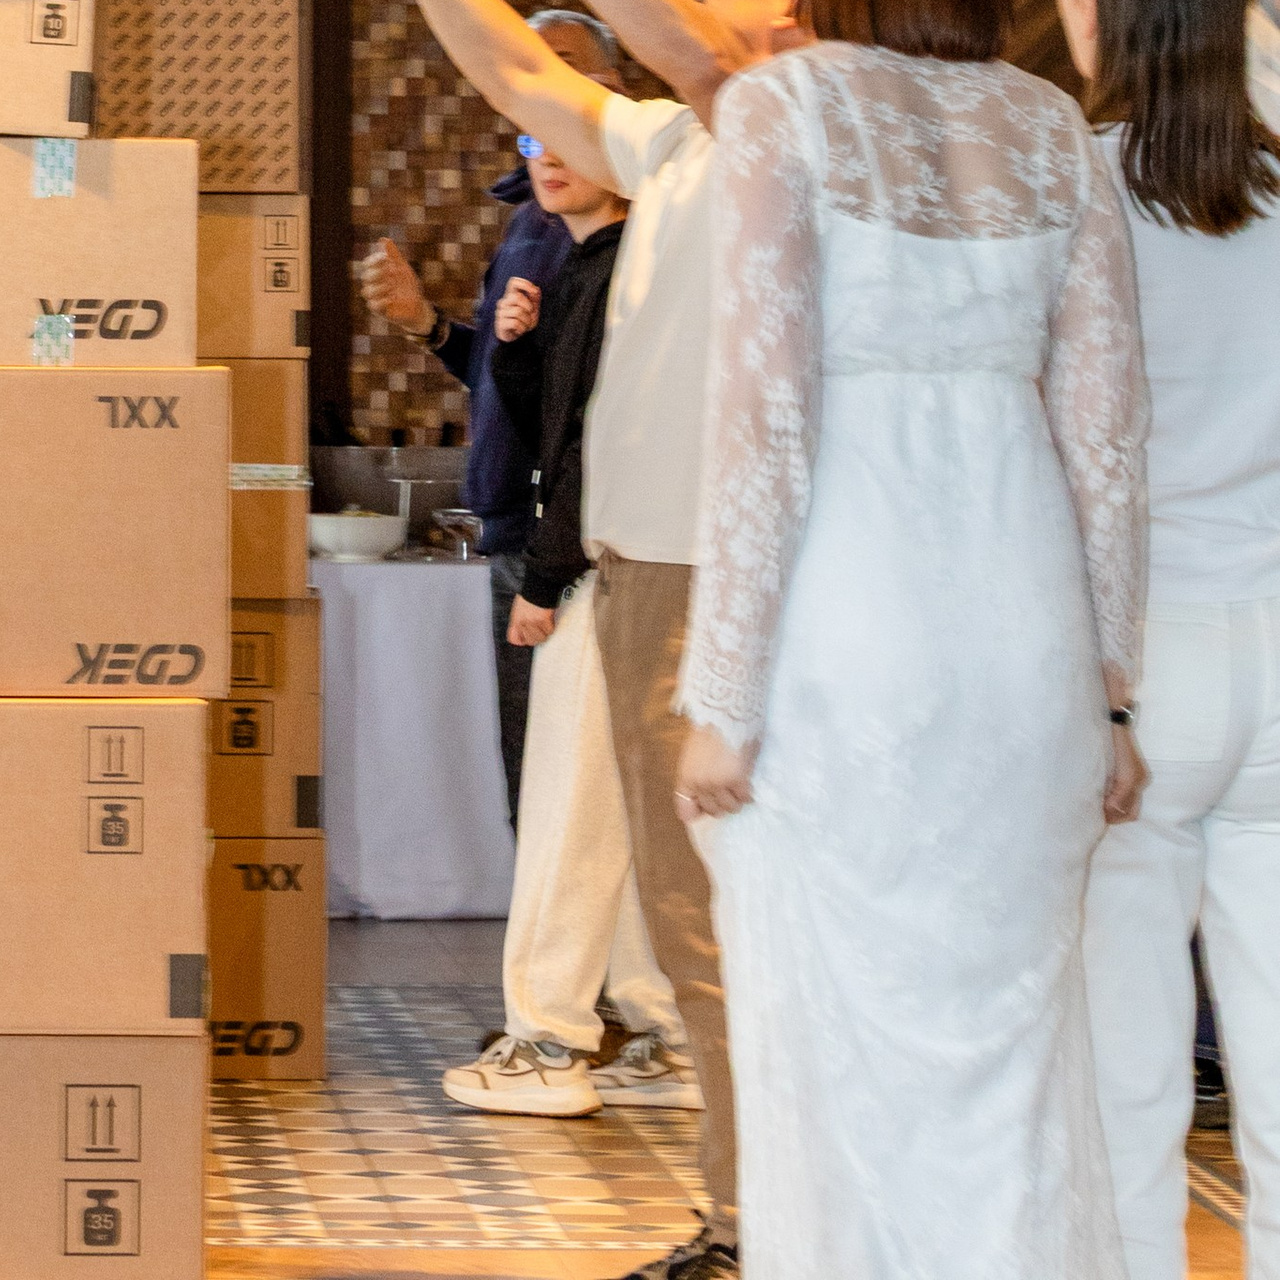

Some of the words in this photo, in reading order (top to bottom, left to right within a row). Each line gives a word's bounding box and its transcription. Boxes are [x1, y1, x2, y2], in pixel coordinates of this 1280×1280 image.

[97, 396, 179, 428] XXL
[66, 643, 205, 685] CDEK
[210, 1020, 304, 1057] CDE
[90, 1214, 113, 1229] 35
